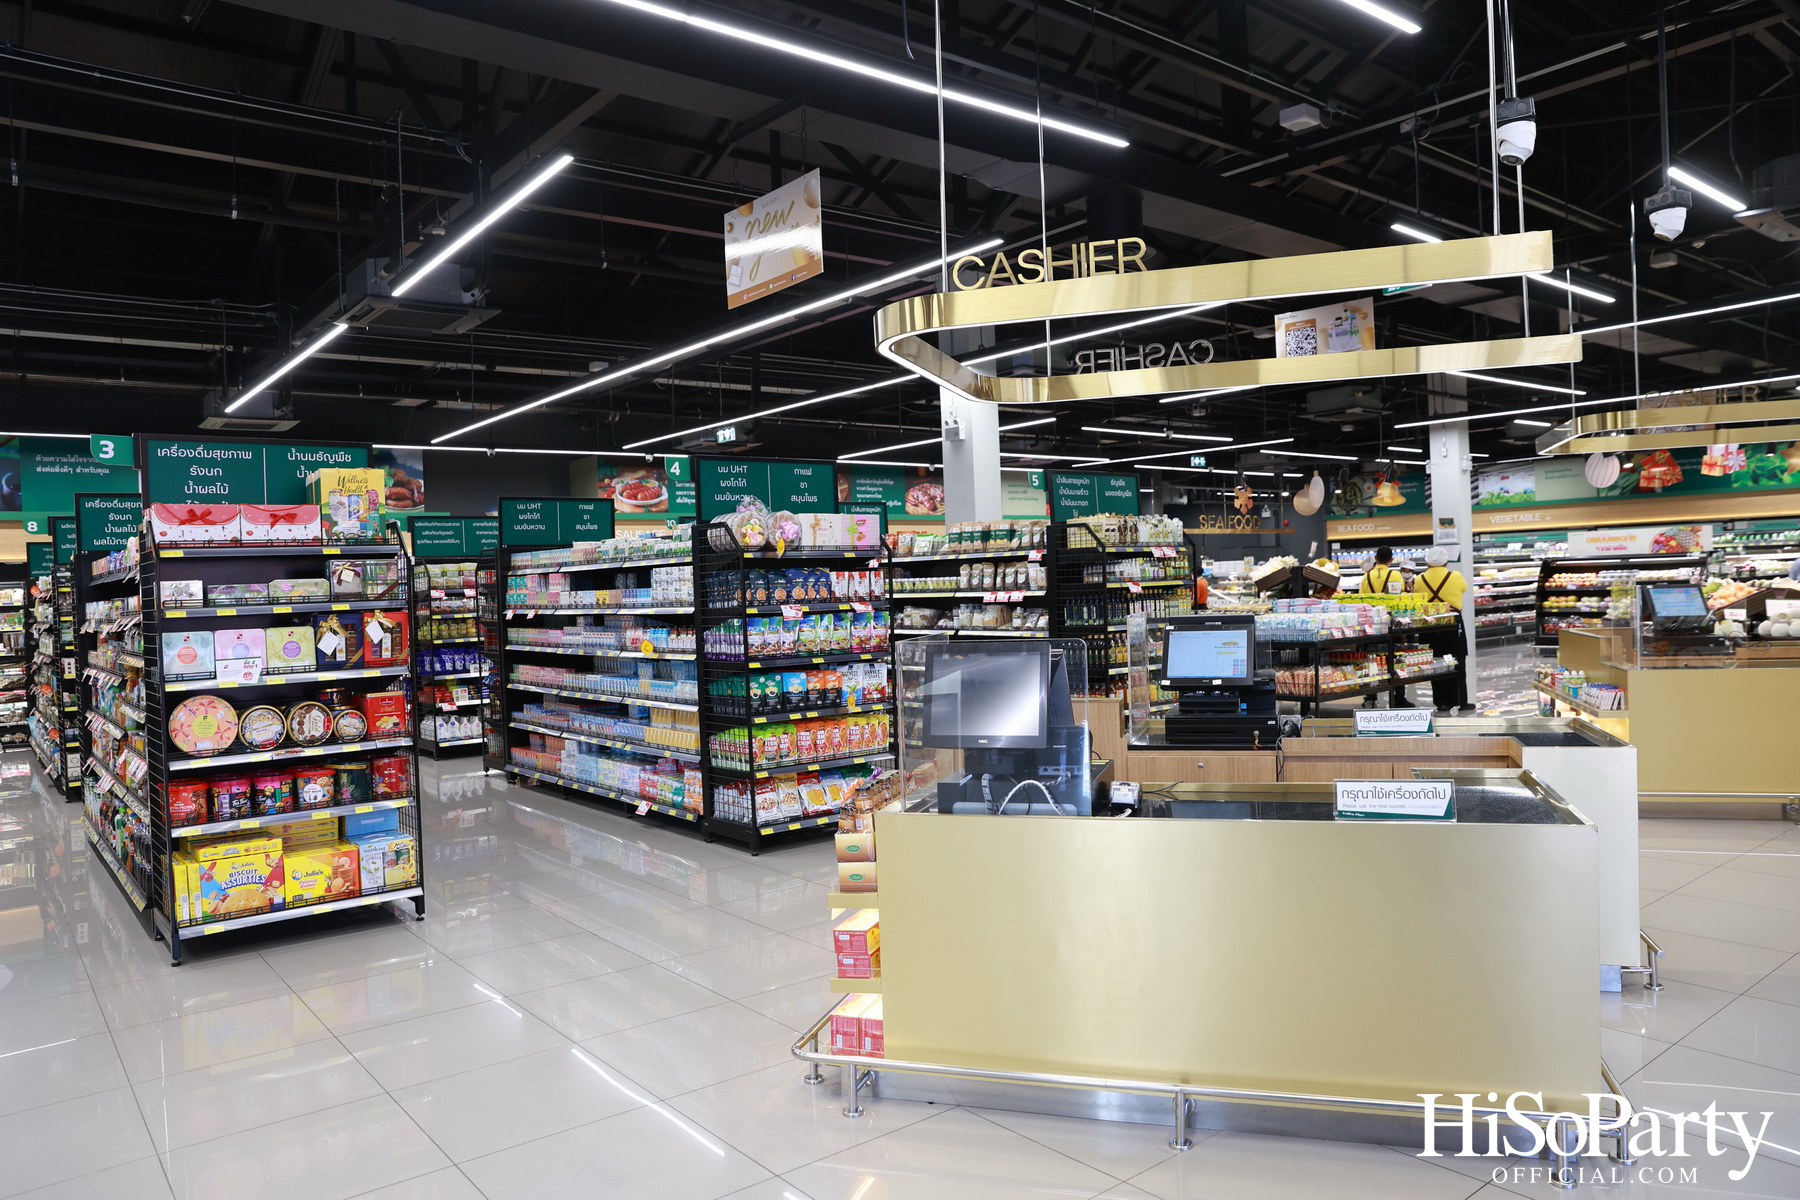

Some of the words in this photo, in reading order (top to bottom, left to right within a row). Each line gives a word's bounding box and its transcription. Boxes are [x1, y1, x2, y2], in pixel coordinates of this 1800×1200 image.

[744, 200, 795, 239] new
[953, 237, 1149, 291] CASHIER
[99, 440, 115, 459] 3
[156, 443, 253, 461] เครื่องดื่มสุขภาพ
[287, 447, 352, 464] น้ำนมธัญพืช
[189, 464, 223, 477] รังนก
[670, 461, 681, 476] 4
[717, 465, 729, 473] นม
[730, 465, 748, 473] UHT
[793, 467, 812, 476] กาแฟ
[184, 480, 229, 494] น้ำผลไม้
[337, 474, 368, 488] Wellness
[720, 477, 747, 487] ผงโกโก้
[799, 481, 808, 489] ชา
[1032, 475, 1040, 487] 5
[85, 498, 143, 510] เครื่องดื่มสุขภ
[790, 493, 818, 503] สมุนไพร
[108, 512, 132, 521] รังนก
[1199, 514, 1225, 529] SEA
[1228, 514, 1260, 529] FOOD
[1489, 512, 1542, 524] VEGETABLE
[27, 521, 38, 532] 8
[104, 523, 137, 533] น้ำผลไม้
[1337, 525, 1352, 533] SEA
[1352, 523, 1375, 532] FOOD
[93, 536, 128, 545] ผลไม้กร
[1359, 712, 1428, 725] กรุณาใช้เครื่องถัดไป
[1341, 785, 1446, 802] กรุณาใช้เครื่องถัดไป
[228, 869, 258, 878] BISCUIT
[303, 869, 324, 878] Julie's
[221, 874, 267, 890] ASSORTIES
